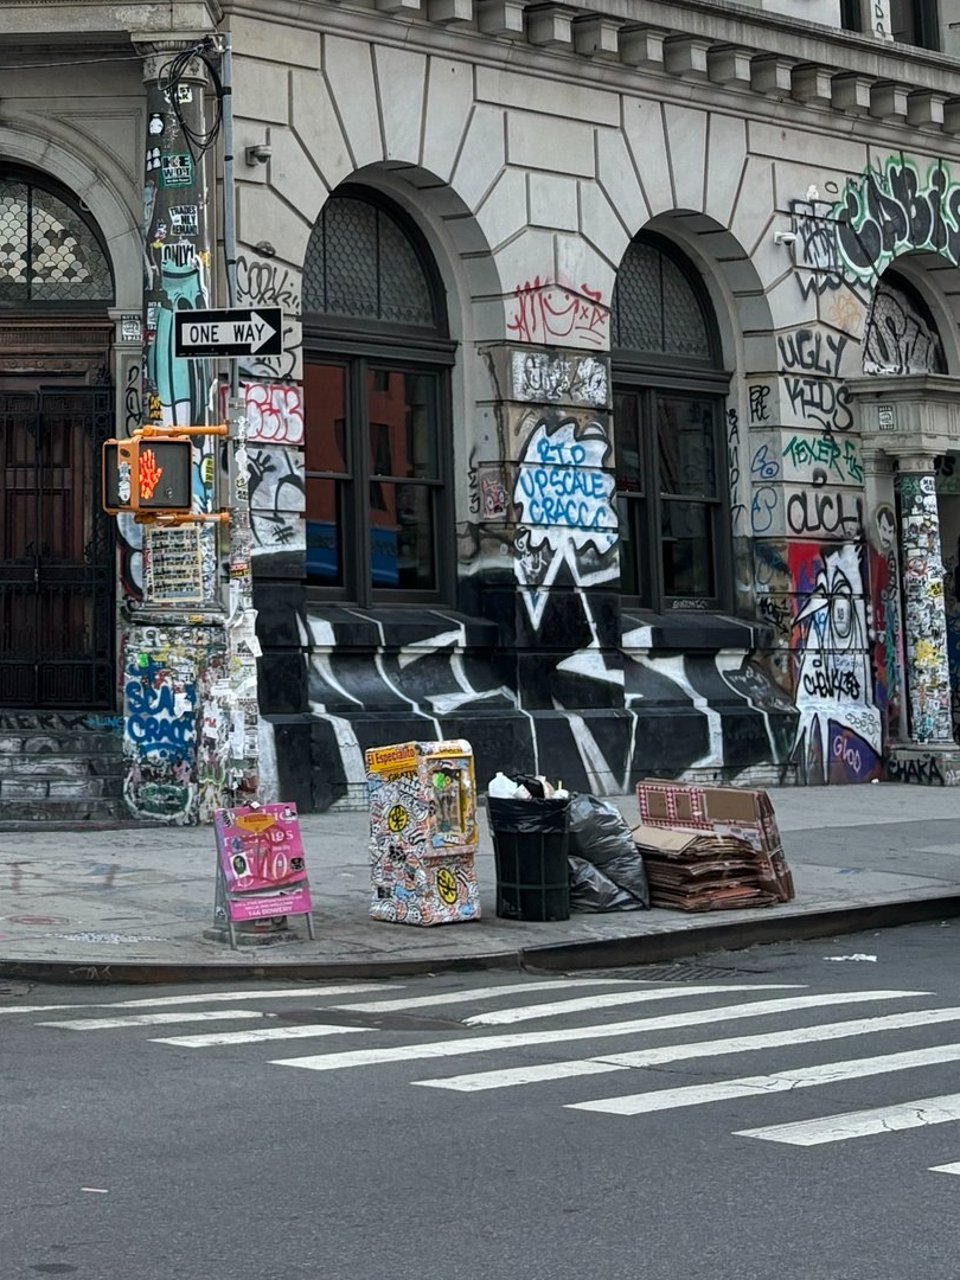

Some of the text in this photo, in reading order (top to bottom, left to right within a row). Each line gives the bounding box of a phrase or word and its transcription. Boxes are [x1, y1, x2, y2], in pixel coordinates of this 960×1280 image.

[190, 322, 265, 344] ONE WAY
[520, 469, 608, 499] UPSCALE
